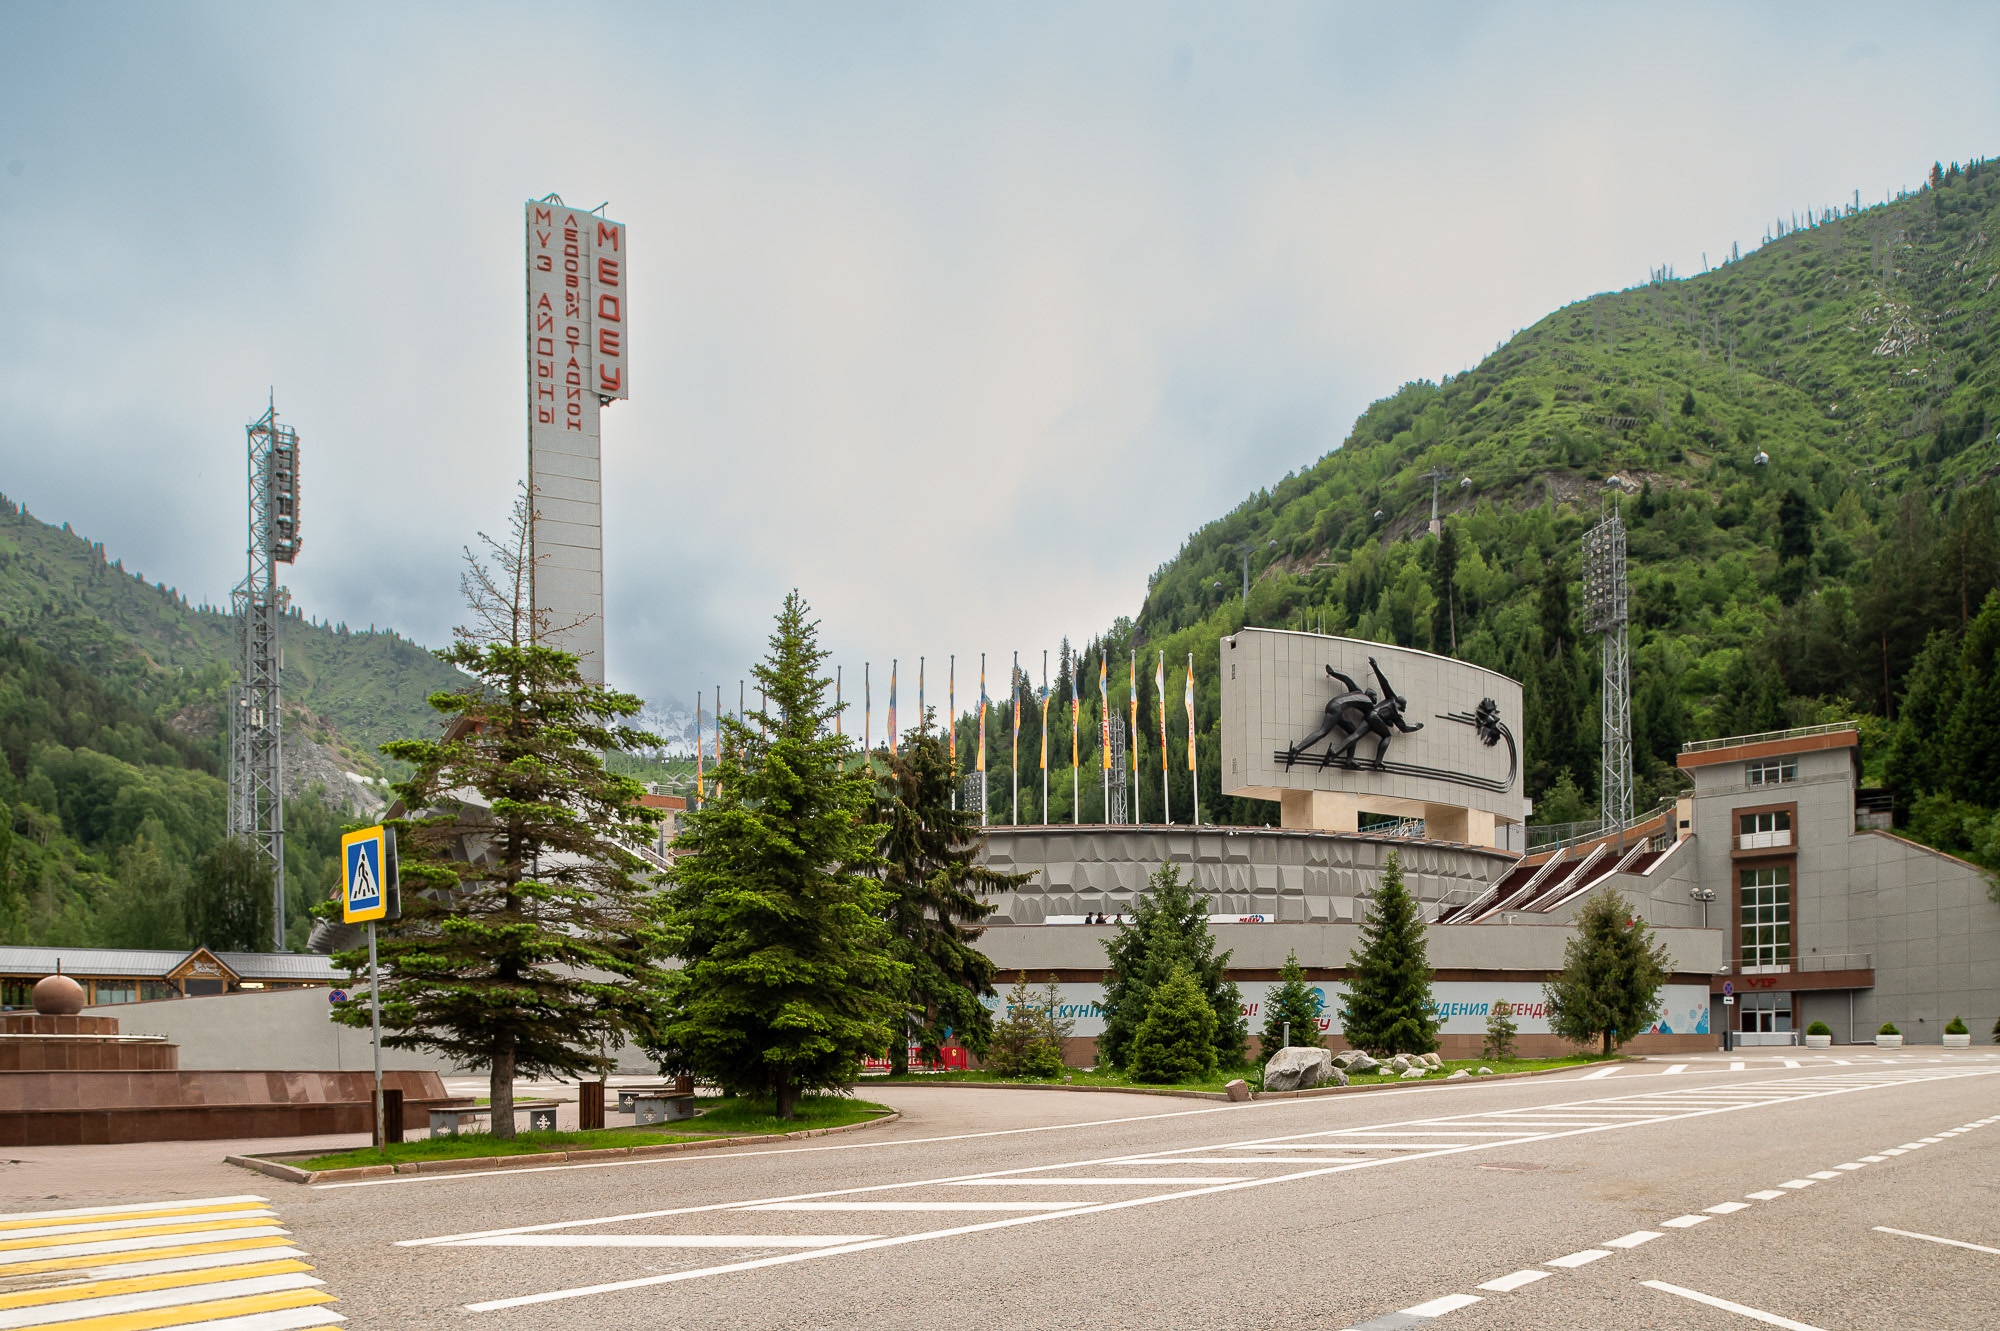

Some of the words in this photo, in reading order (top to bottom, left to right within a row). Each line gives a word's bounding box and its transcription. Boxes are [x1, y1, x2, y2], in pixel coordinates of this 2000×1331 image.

[564, 213, 580, 319] ЛЕДОВЫЙ
[598, 222, 621, 391] МЕДЕУ
[537, 292, 554, 424] АЙДЫНЫ
[565, 325, 581, 431] СТАДИОН
[1747, 978, 1778, 987] VIP
